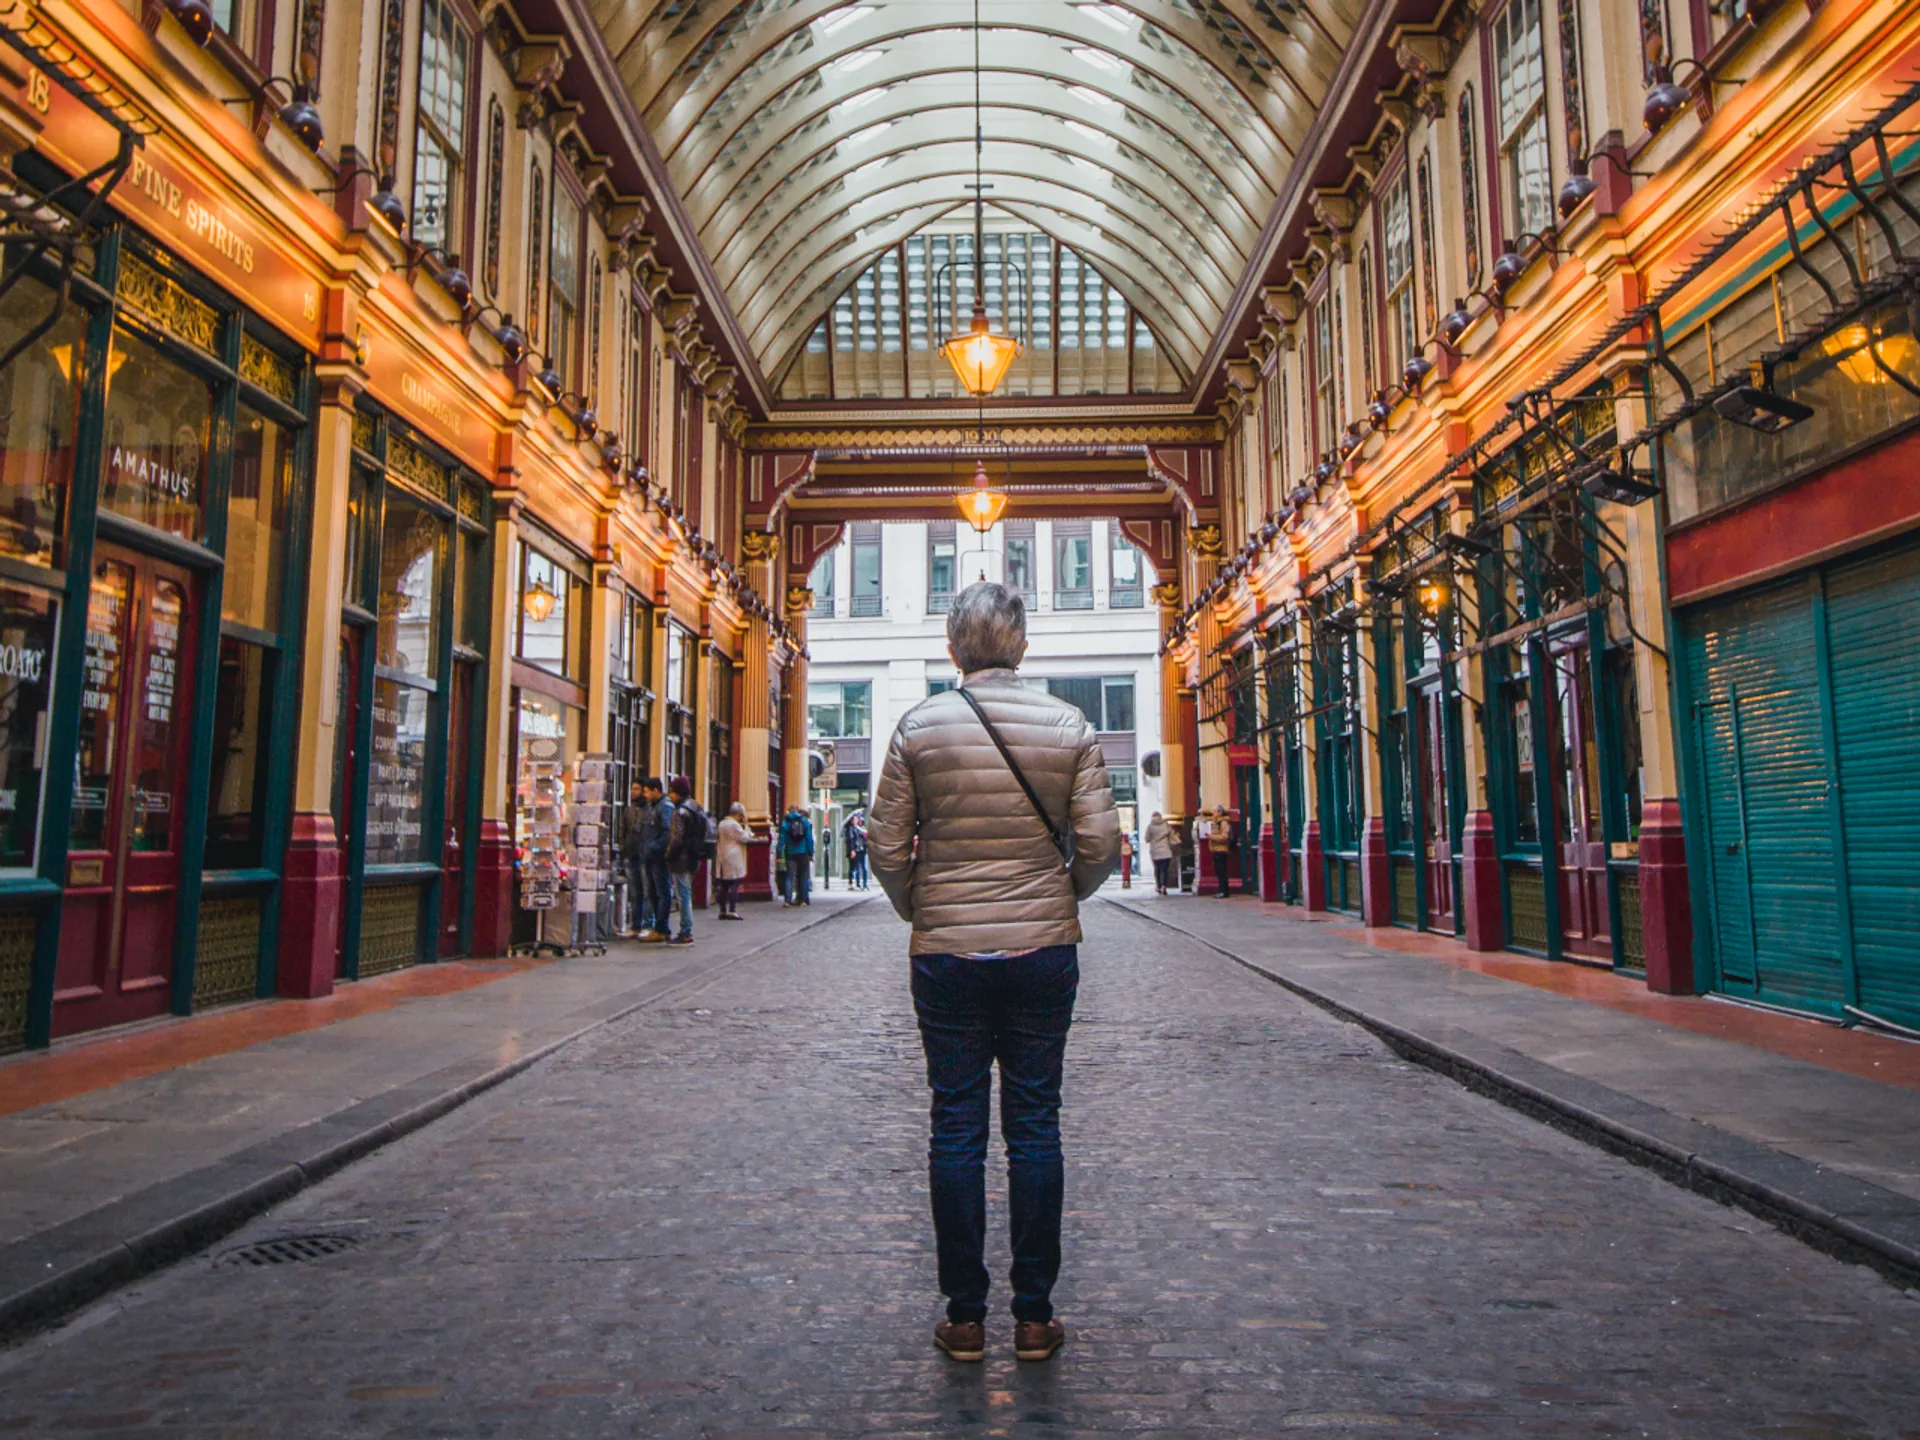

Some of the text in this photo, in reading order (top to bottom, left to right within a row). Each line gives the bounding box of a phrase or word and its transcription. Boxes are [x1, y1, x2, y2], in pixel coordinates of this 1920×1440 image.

[28, 68, 49, 113] 18
[132, 154, 254, 274] FINE SPIRITS
[402, 372, 461, 436] CHAMPAGNE
[112, 445, 189, 498] AMATHUS
